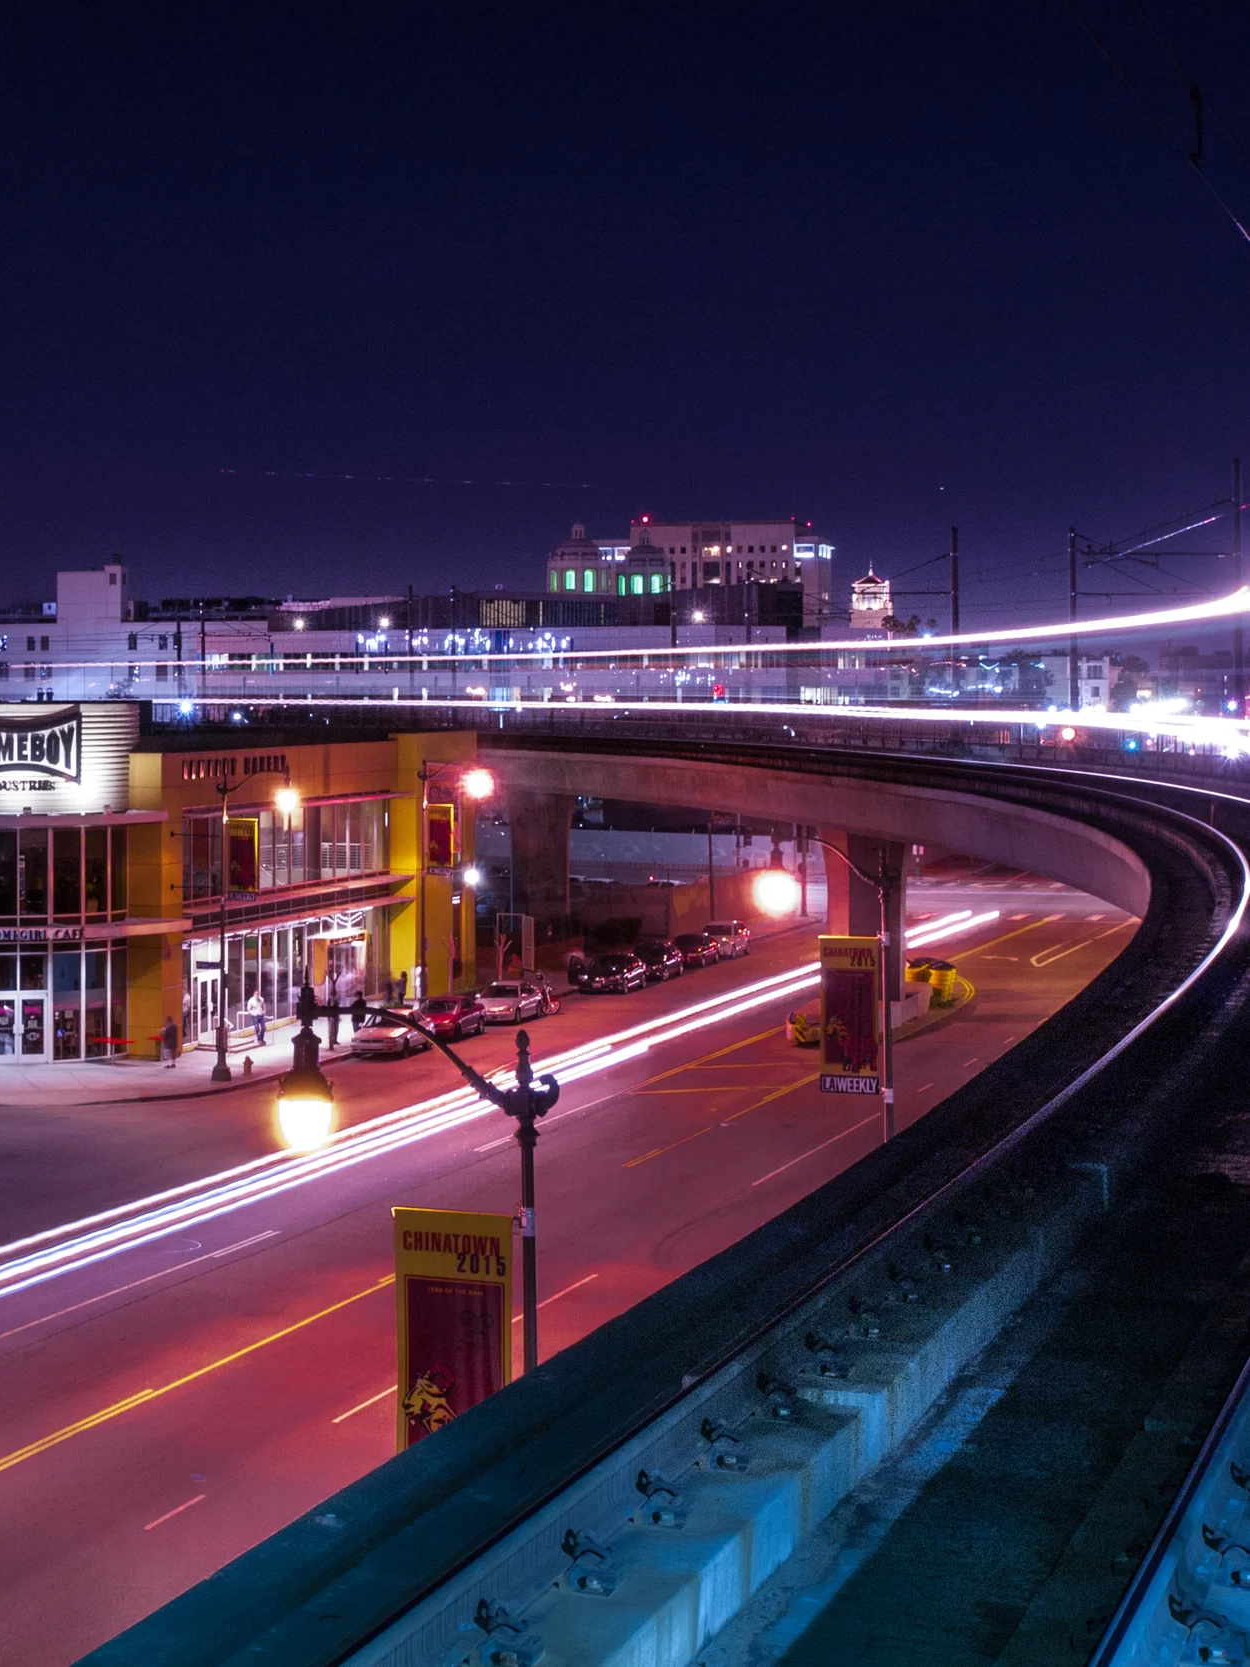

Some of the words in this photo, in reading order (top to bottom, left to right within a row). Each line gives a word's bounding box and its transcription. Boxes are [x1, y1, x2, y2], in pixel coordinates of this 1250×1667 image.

[823, 946, 873, 958] CHINATOWN
[850, 956, 876, 968] 2015
[837, 1077, 877, 1093] WEEKLY
[402, 1229, 501, 1257] CHINATOWN
[456, 1252, 507, 1277] 2015
[444, 1287, 453, 1295] OF
